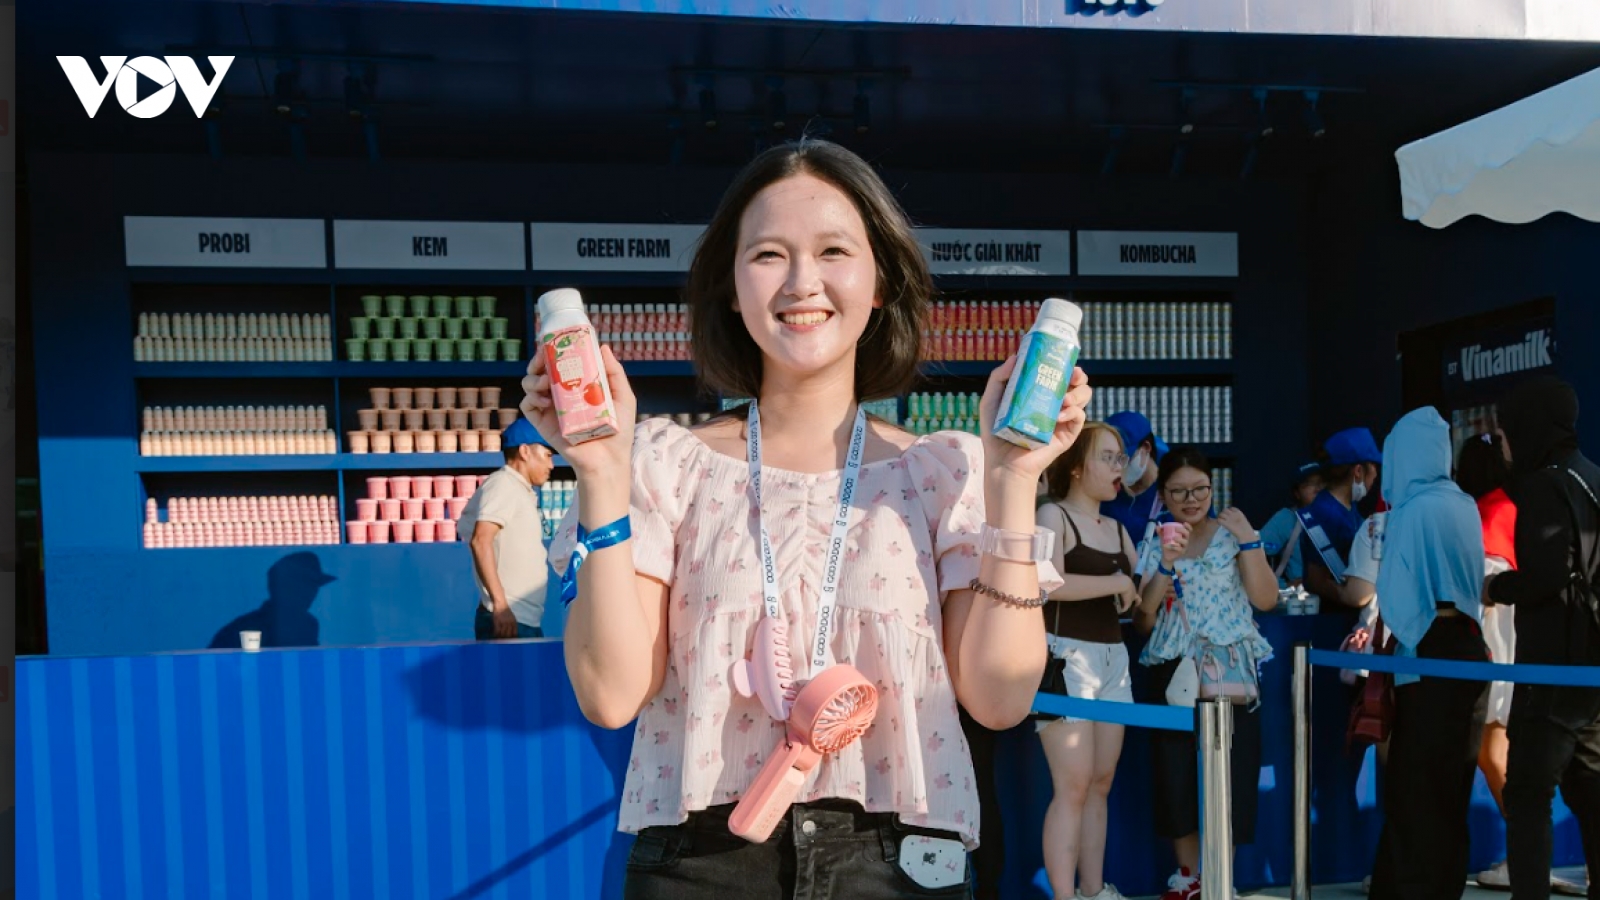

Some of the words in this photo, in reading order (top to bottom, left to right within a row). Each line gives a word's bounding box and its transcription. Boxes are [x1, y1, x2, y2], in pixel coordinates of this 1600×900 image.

[198, 232, 250, 254] PROBI
[412, 236, 448, 257] KEM
[576, 237, 625, 258] GREEN
[628, 238, 671, 258] FARM
[974, 239, 1002, 262] GIẢI
[1120, 244, 1197, 264] KOMBUCHA
[1461, 329, 1552, 382] Vinamilk
